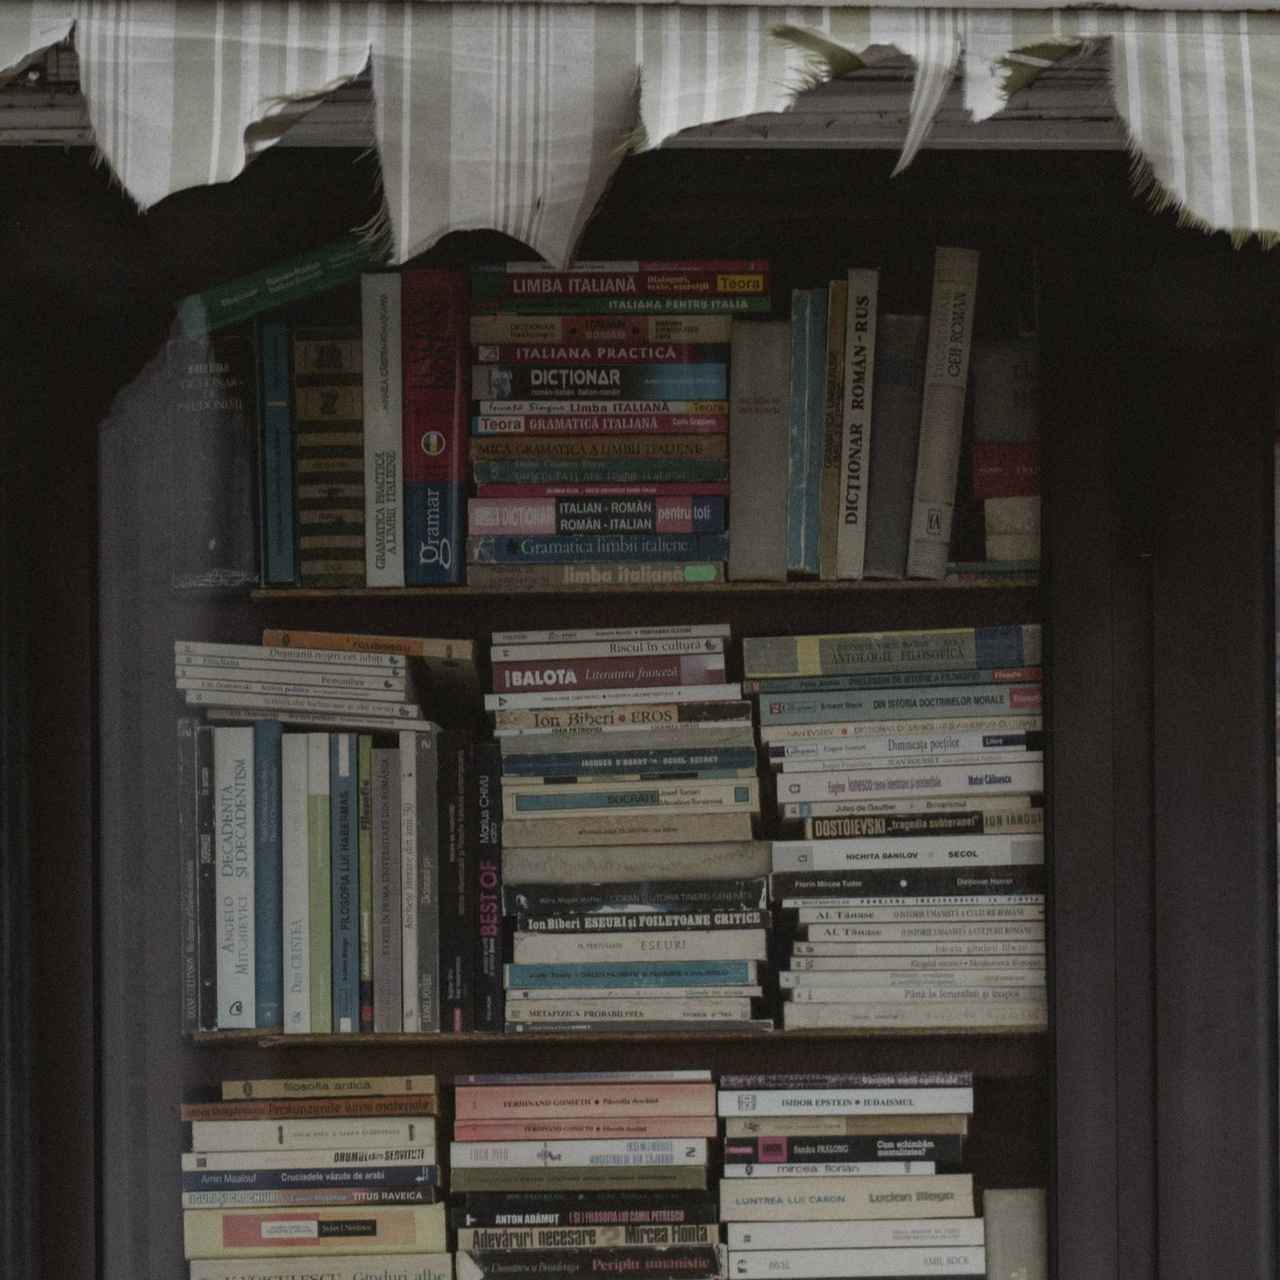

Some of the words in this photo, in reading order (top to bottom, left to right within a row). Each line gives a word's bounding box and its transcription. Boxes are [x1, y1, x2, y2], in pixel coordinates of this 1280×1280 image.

[513, 278, 562, 293] LIMBA
[569, 276, 635, 292] ITALIANĂ
[720, 277, 760, 289] Teora
[666, 300, 708, 308] PENTRU
[711, 300, 748, 308] ITALIA
[516, 348, 596, 358] ITALIANA
[602, 346, 675, 358] PRACTICĂ
[531, 369, 620, 391] DICȚIONAR
[693, 404, 724, 412] Teora
[483, 419, 521, 429] Teora
[530, 417, 599, 428] GRAMATICĂ
[603, 417, 657, 428] ITALIANĂ
[560, 503, 601, 513] ITALIAN
[611, 500, 652, 512] ROMÂN
[560, 517, 601, 530] ROMÂN
[610, 519, 651, 529] ITALIAN
[521, 540, 592, 554] Gramatica
[597, 538, 637, 552] limbii
[641, 538, 688, 551] italiene
[564, 568, 614, 583] limba
[610, 642, 643, 653] Riscul
[647, 642, 658, 652] în
[585, 670, 635, 680] Literatura
[873, 702, 886, 710] DIN
[888, 700, 917, 709] ISTORIA
[920, 697, 970, 708] DOCTRINELOR
[973, 695, 1004, 705] MORALE
[534, 714, 560, 728] Ion
[568, 711, 614, 726] Biberi
[631, 710, 672, 722] EROS
[479, 775, 488, 807] CHIVU
[235, 759, 247, 861] DECADENTISM
[339, 790, 349, 851] HABERMAS
[480, 811, 489, 844] Marius
[846, 852, 880, 860] NICHITA
[948, 850, 978, 858] SECOL
[339, 855, 350, 871] LUI
[481, 862, 497, 887] OF
[340, 875, 350, 930] FILOSOFIA
[481, 894, 498, 936] BEST
[529, 919, 545, 929] Ion
[547, 918, 580, 928] Biberi
[585, 917, 626, 928] ESEURI
[639, 914, 710, 926] FOILETOANE
[715, 913, 760, 924] CRITICE
[222, 896, 234, 952] ANGELO
[236, 897, 248, 974] MITCHIEVICI
[291, 919, 302, 969] CRISTEA
[641, 940, 686, 950] ESEURI
[291, 973, 302, 993] Dan
[782, 1097, 813, 1106] ISIDOR
[815, 1097, 852, 1106] EPSTEIN
[863, 1097, 915, 1106] IUDAISMUL
[777, 1164, 818, 1173] mircea
[825, 1163, 859, 1173] florian
[202, 1174, 222, 1184] Amin
[224, 1173, 257, 1184] Maalouf
[281, 1172, 324, 1181] Cruciadele
[325, 1171, 351, 1181] văzute
[353, 1171, 361, 1180] de
[365, 1171, 384, 1180] arabi
[354, 1192, 378, 1201] TITUS
[382, 1191, 422, 1200] RAVEICA
[736, 1196, 784, 1205] LUNTREA
[787, 1195, 805, 1204] LUI
[809, 1194, 846, 1204] CARON
[538, 1229, 596, 1245] necesare
[625, 1225, 668, 1243] Mircea
